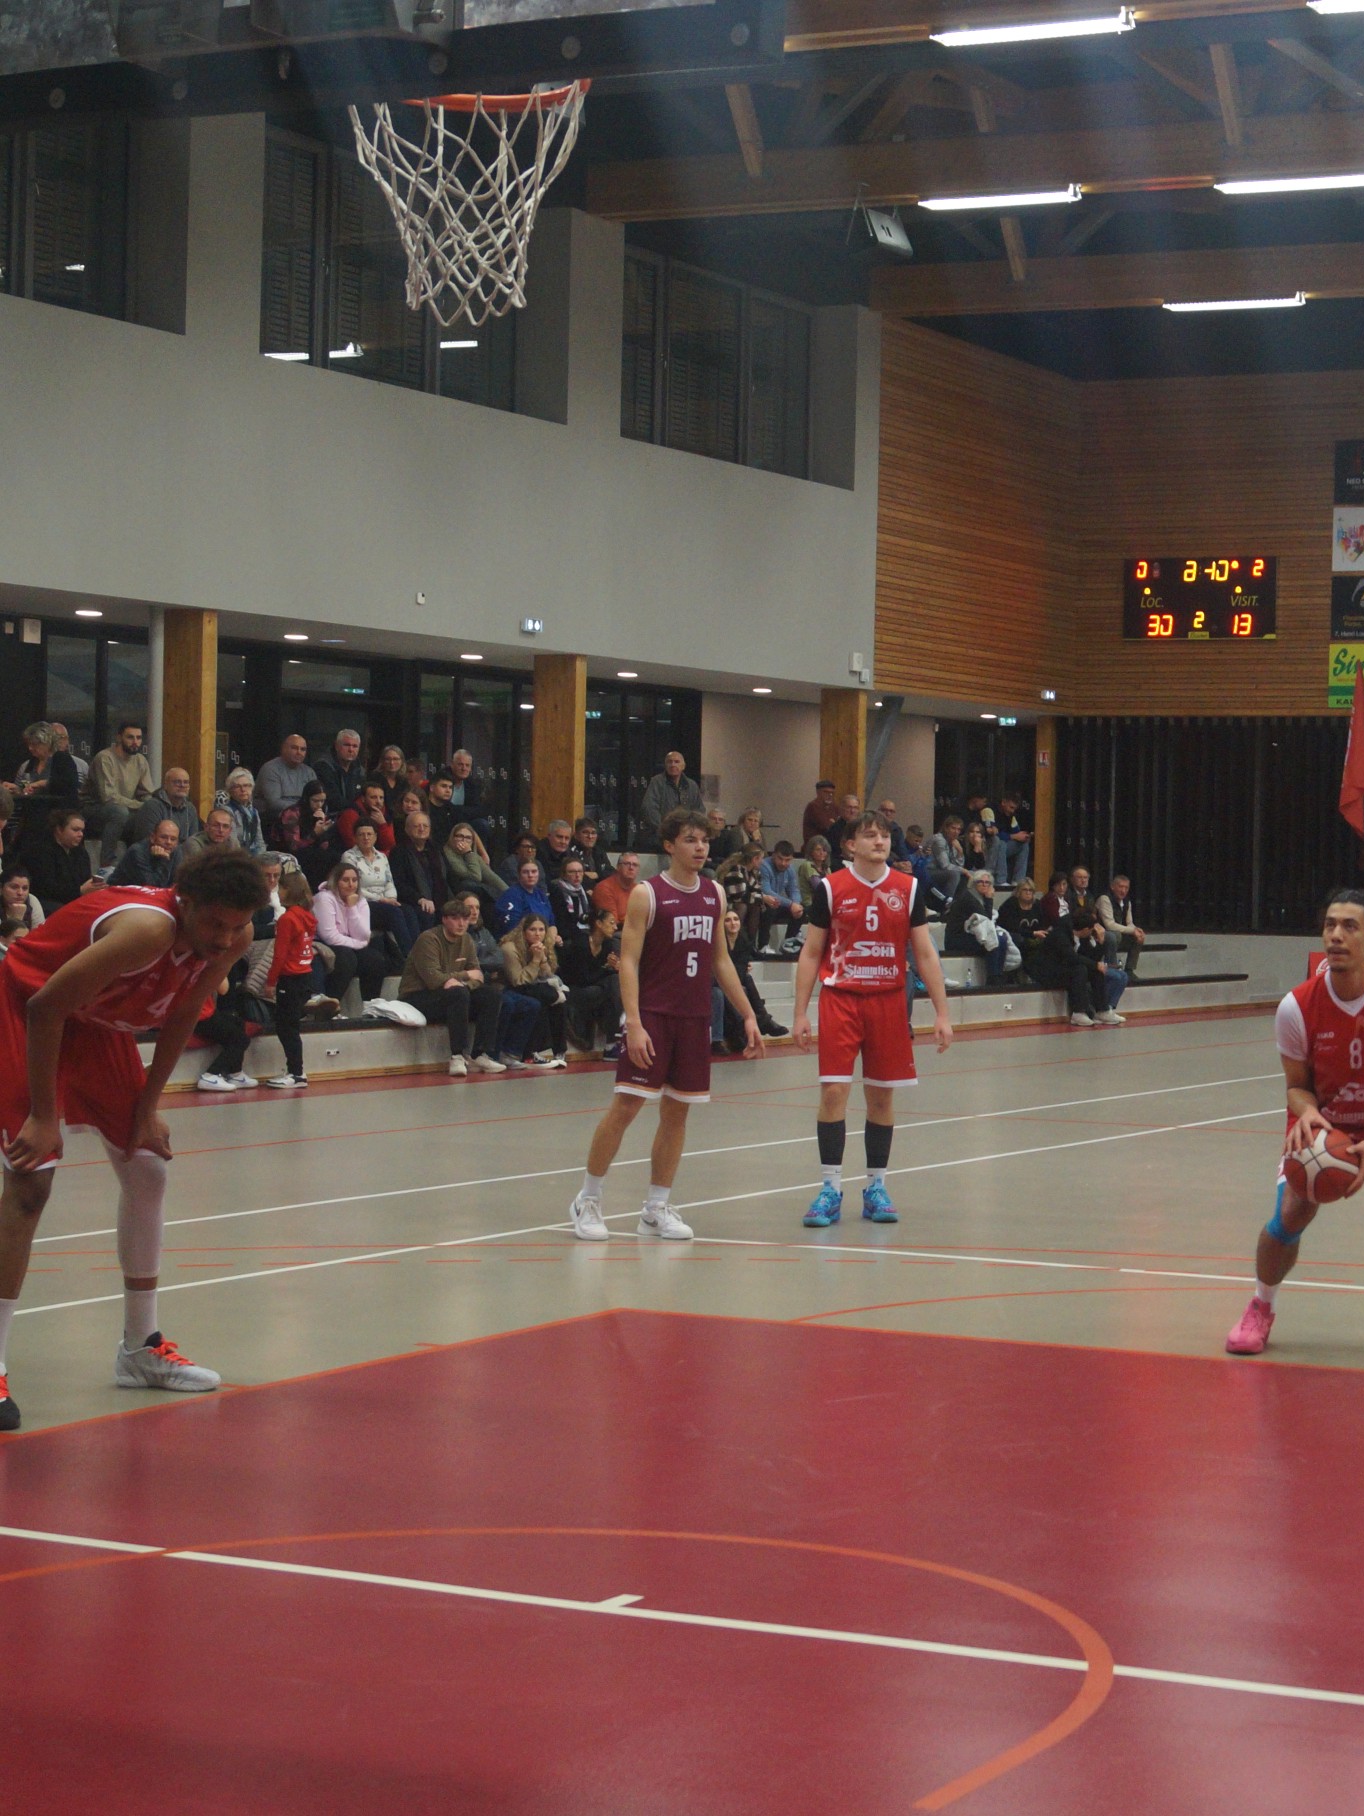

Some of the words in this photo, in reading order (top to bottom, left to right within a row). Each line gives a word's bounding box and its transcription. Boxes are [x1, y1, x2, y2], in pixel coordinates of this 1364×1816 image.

[1346, 477, 1362, 486] NEO
[1252, 558, 1265, 577] 2
[1140, 597, 1165, 609] LOC.
[1230, 595, 1259, 607] VISIT.
[1147, 614, 1174, 637] 30
[1193, 610, 1205, 629] 2
[1232, 613, 1253, 636] 13
[673, 915, 714, 944] ASA
[865, 905, 879, 932] 5
[685, 951, 699, 978] 5
[843, 964, 899, 979] Stammtisch
[1349, 1037, 1363, 1070] 8
